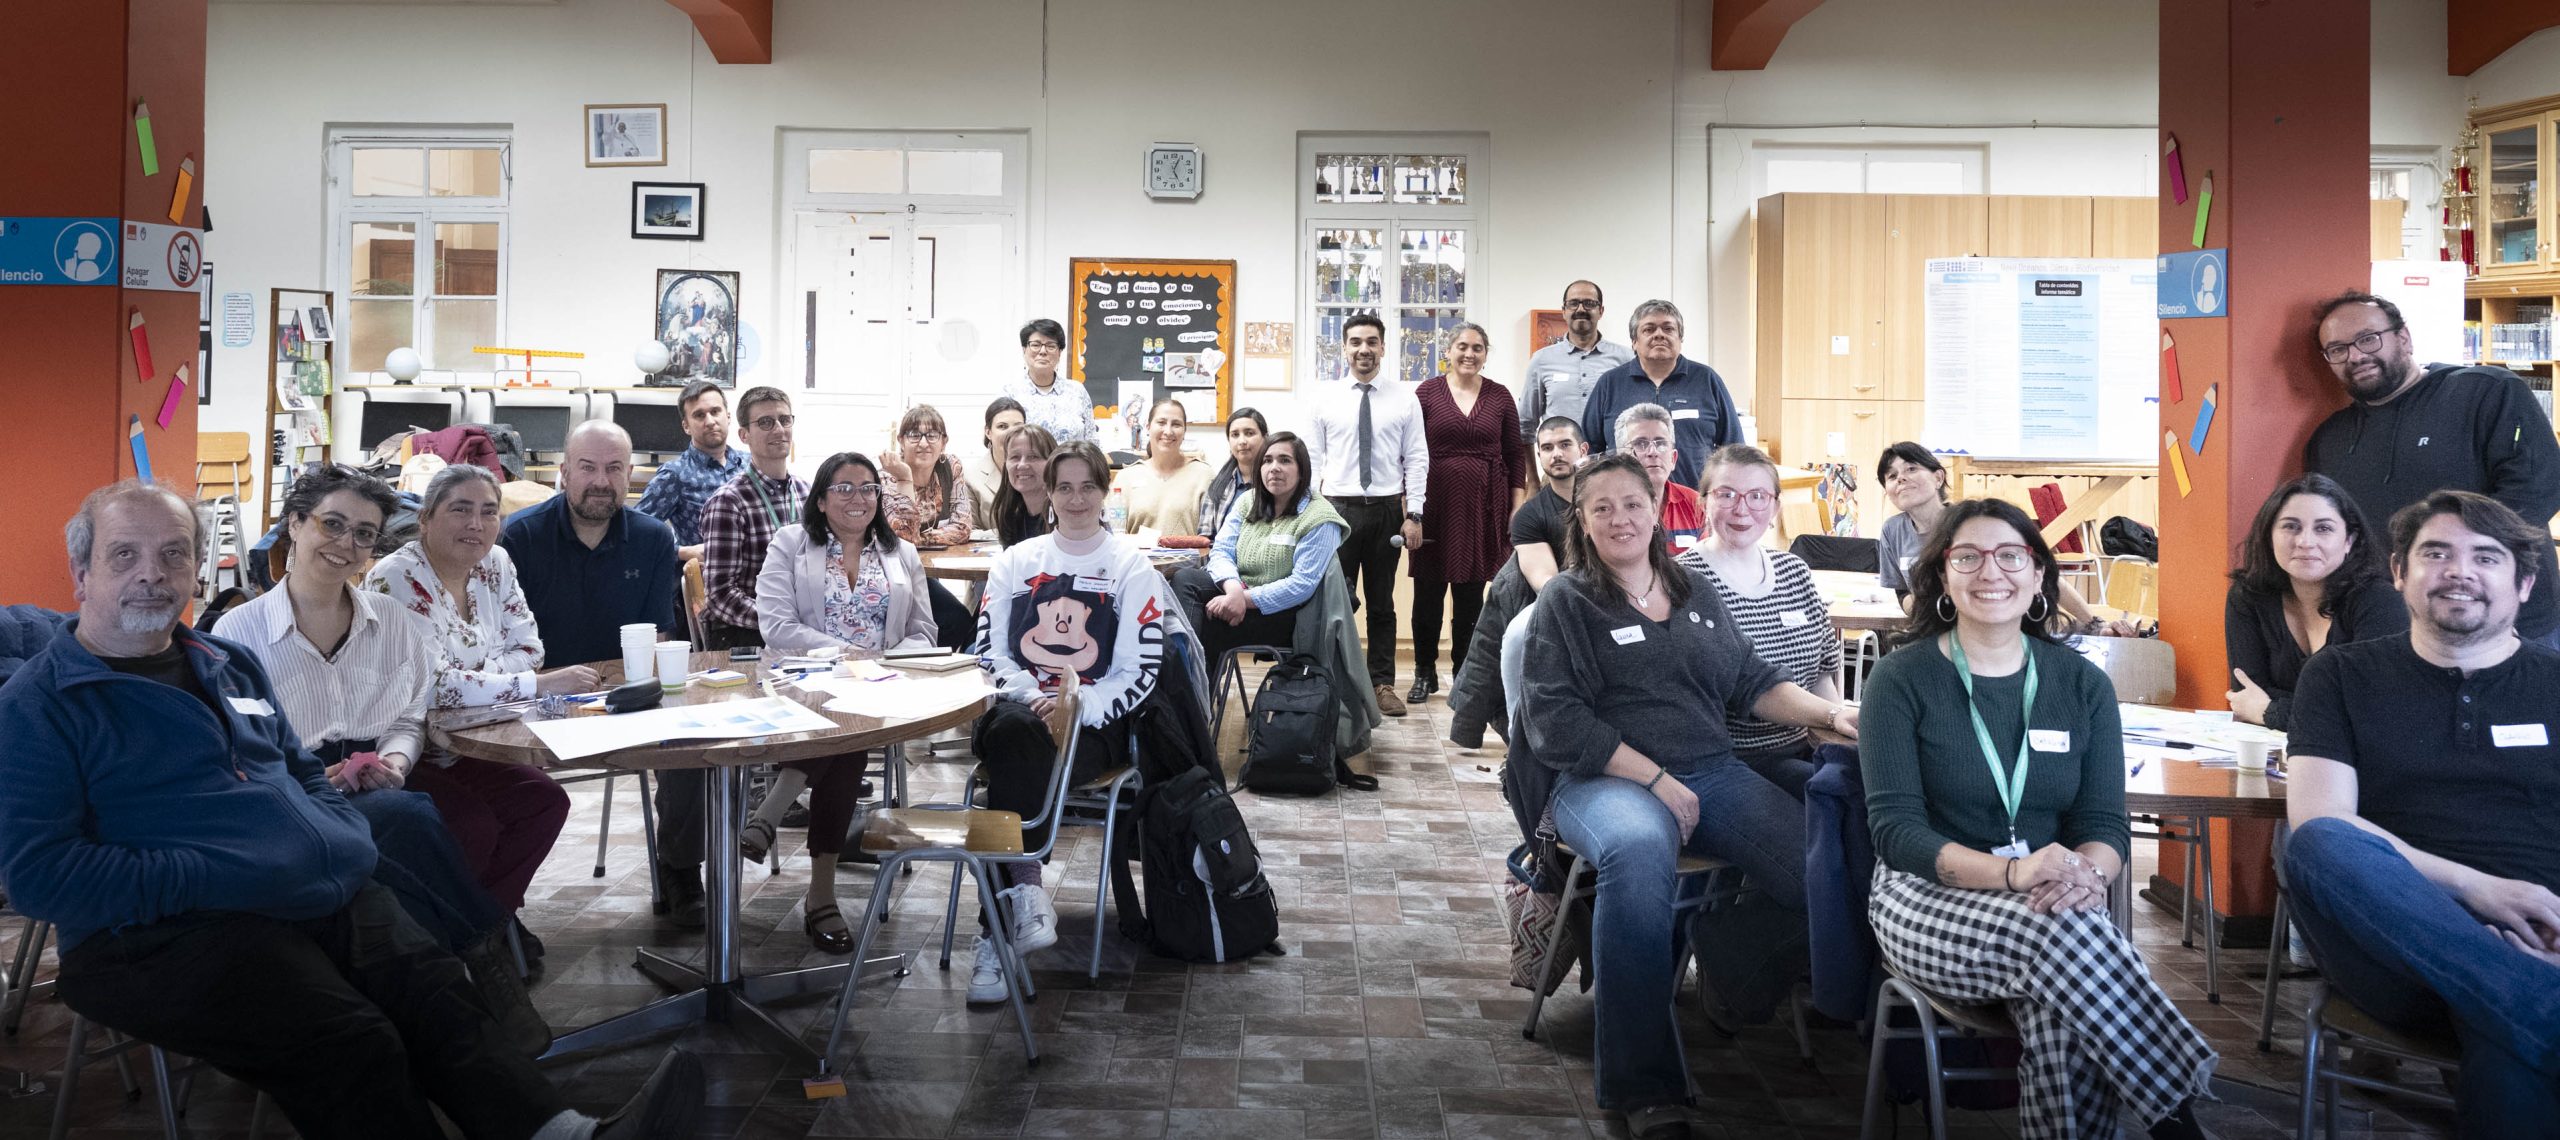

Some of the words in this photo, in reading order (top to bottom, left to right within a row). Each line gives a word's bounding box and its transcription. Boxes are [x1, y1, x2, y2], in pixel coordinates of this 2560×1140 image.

[126, 266, 150, 278] Apagar
[125, 277, 149, 286] Celular
[2158, 302, 2187, 315] Silencio
